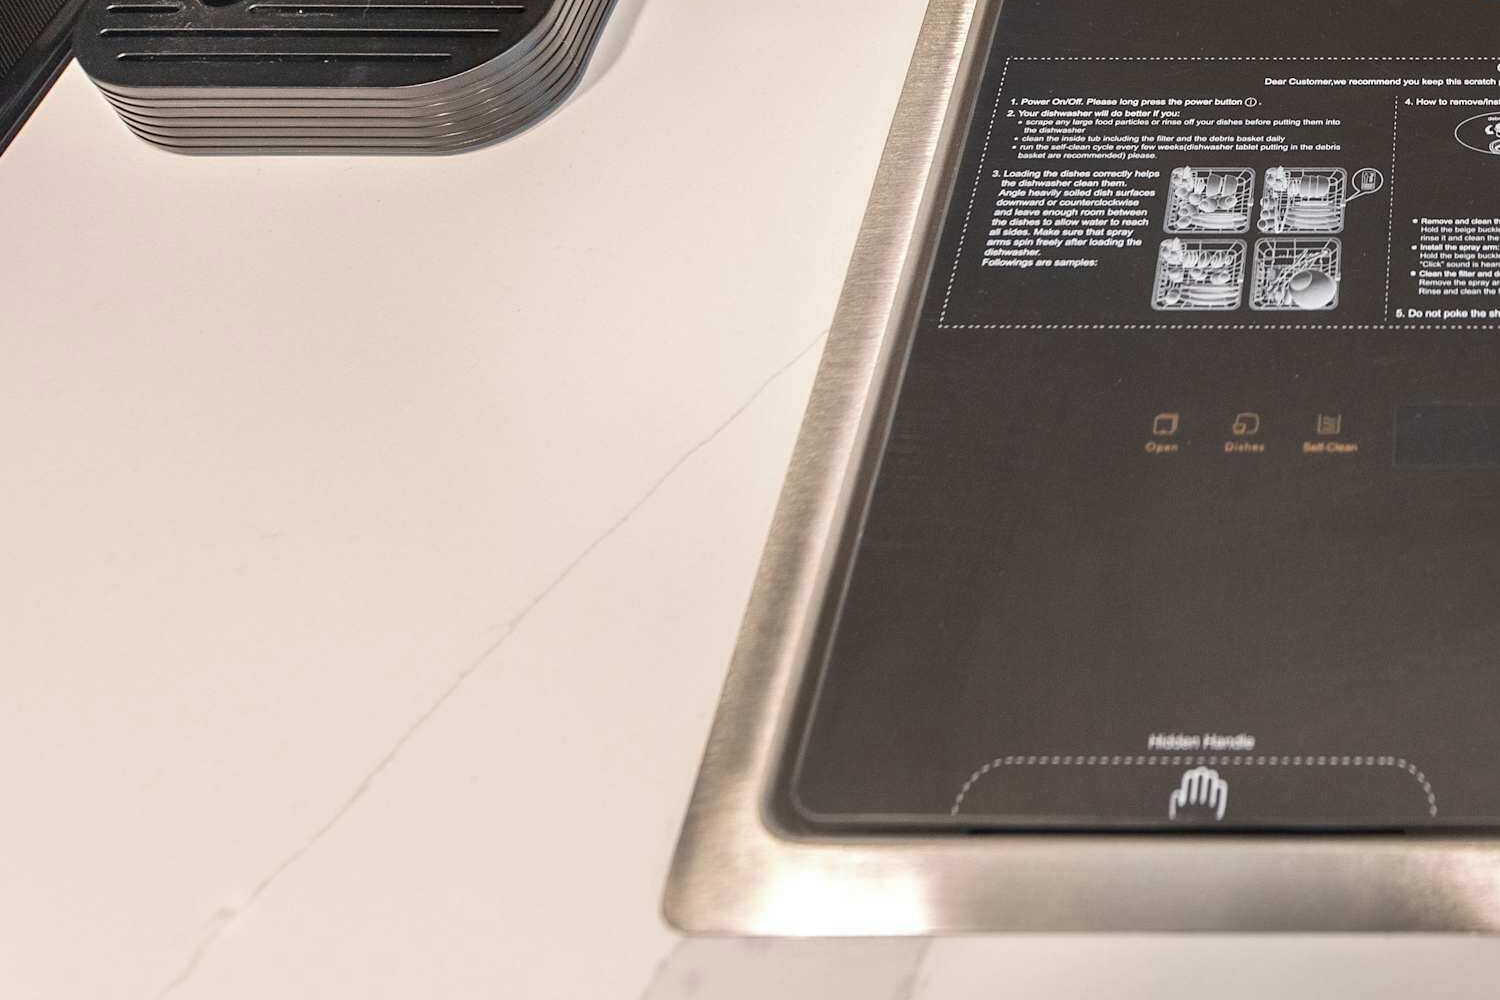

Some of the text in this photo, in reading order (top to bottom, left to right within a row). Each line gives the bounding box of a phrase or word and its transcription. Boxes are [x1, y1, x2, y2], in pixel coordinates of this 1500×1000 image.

[1289, 78, 1347, 86] Customer,we
[1403, 79, 1420, 87] you
[1422, 78, 1444, 86] keep
[1119, 98, 1139, 107] long
[1141, 99, 1166, 107] press
[1184, 99, 1213, 107] power
[1161, 111, 1180, 119] you:
[992, 170, 1160, 179] 3. Loading the dishes correctly helps
[1408, 308, 1423, 318] Do
[1425, 309, 1441, 318] not
[1443, 309, 1468, 320] poke
[1470, 309, 1486, 318] the
[1145, 441, 1179, 453] Open
[1224, 441, 1265, 452] Dishes
[1202, 732, 1256, 750] Handle
